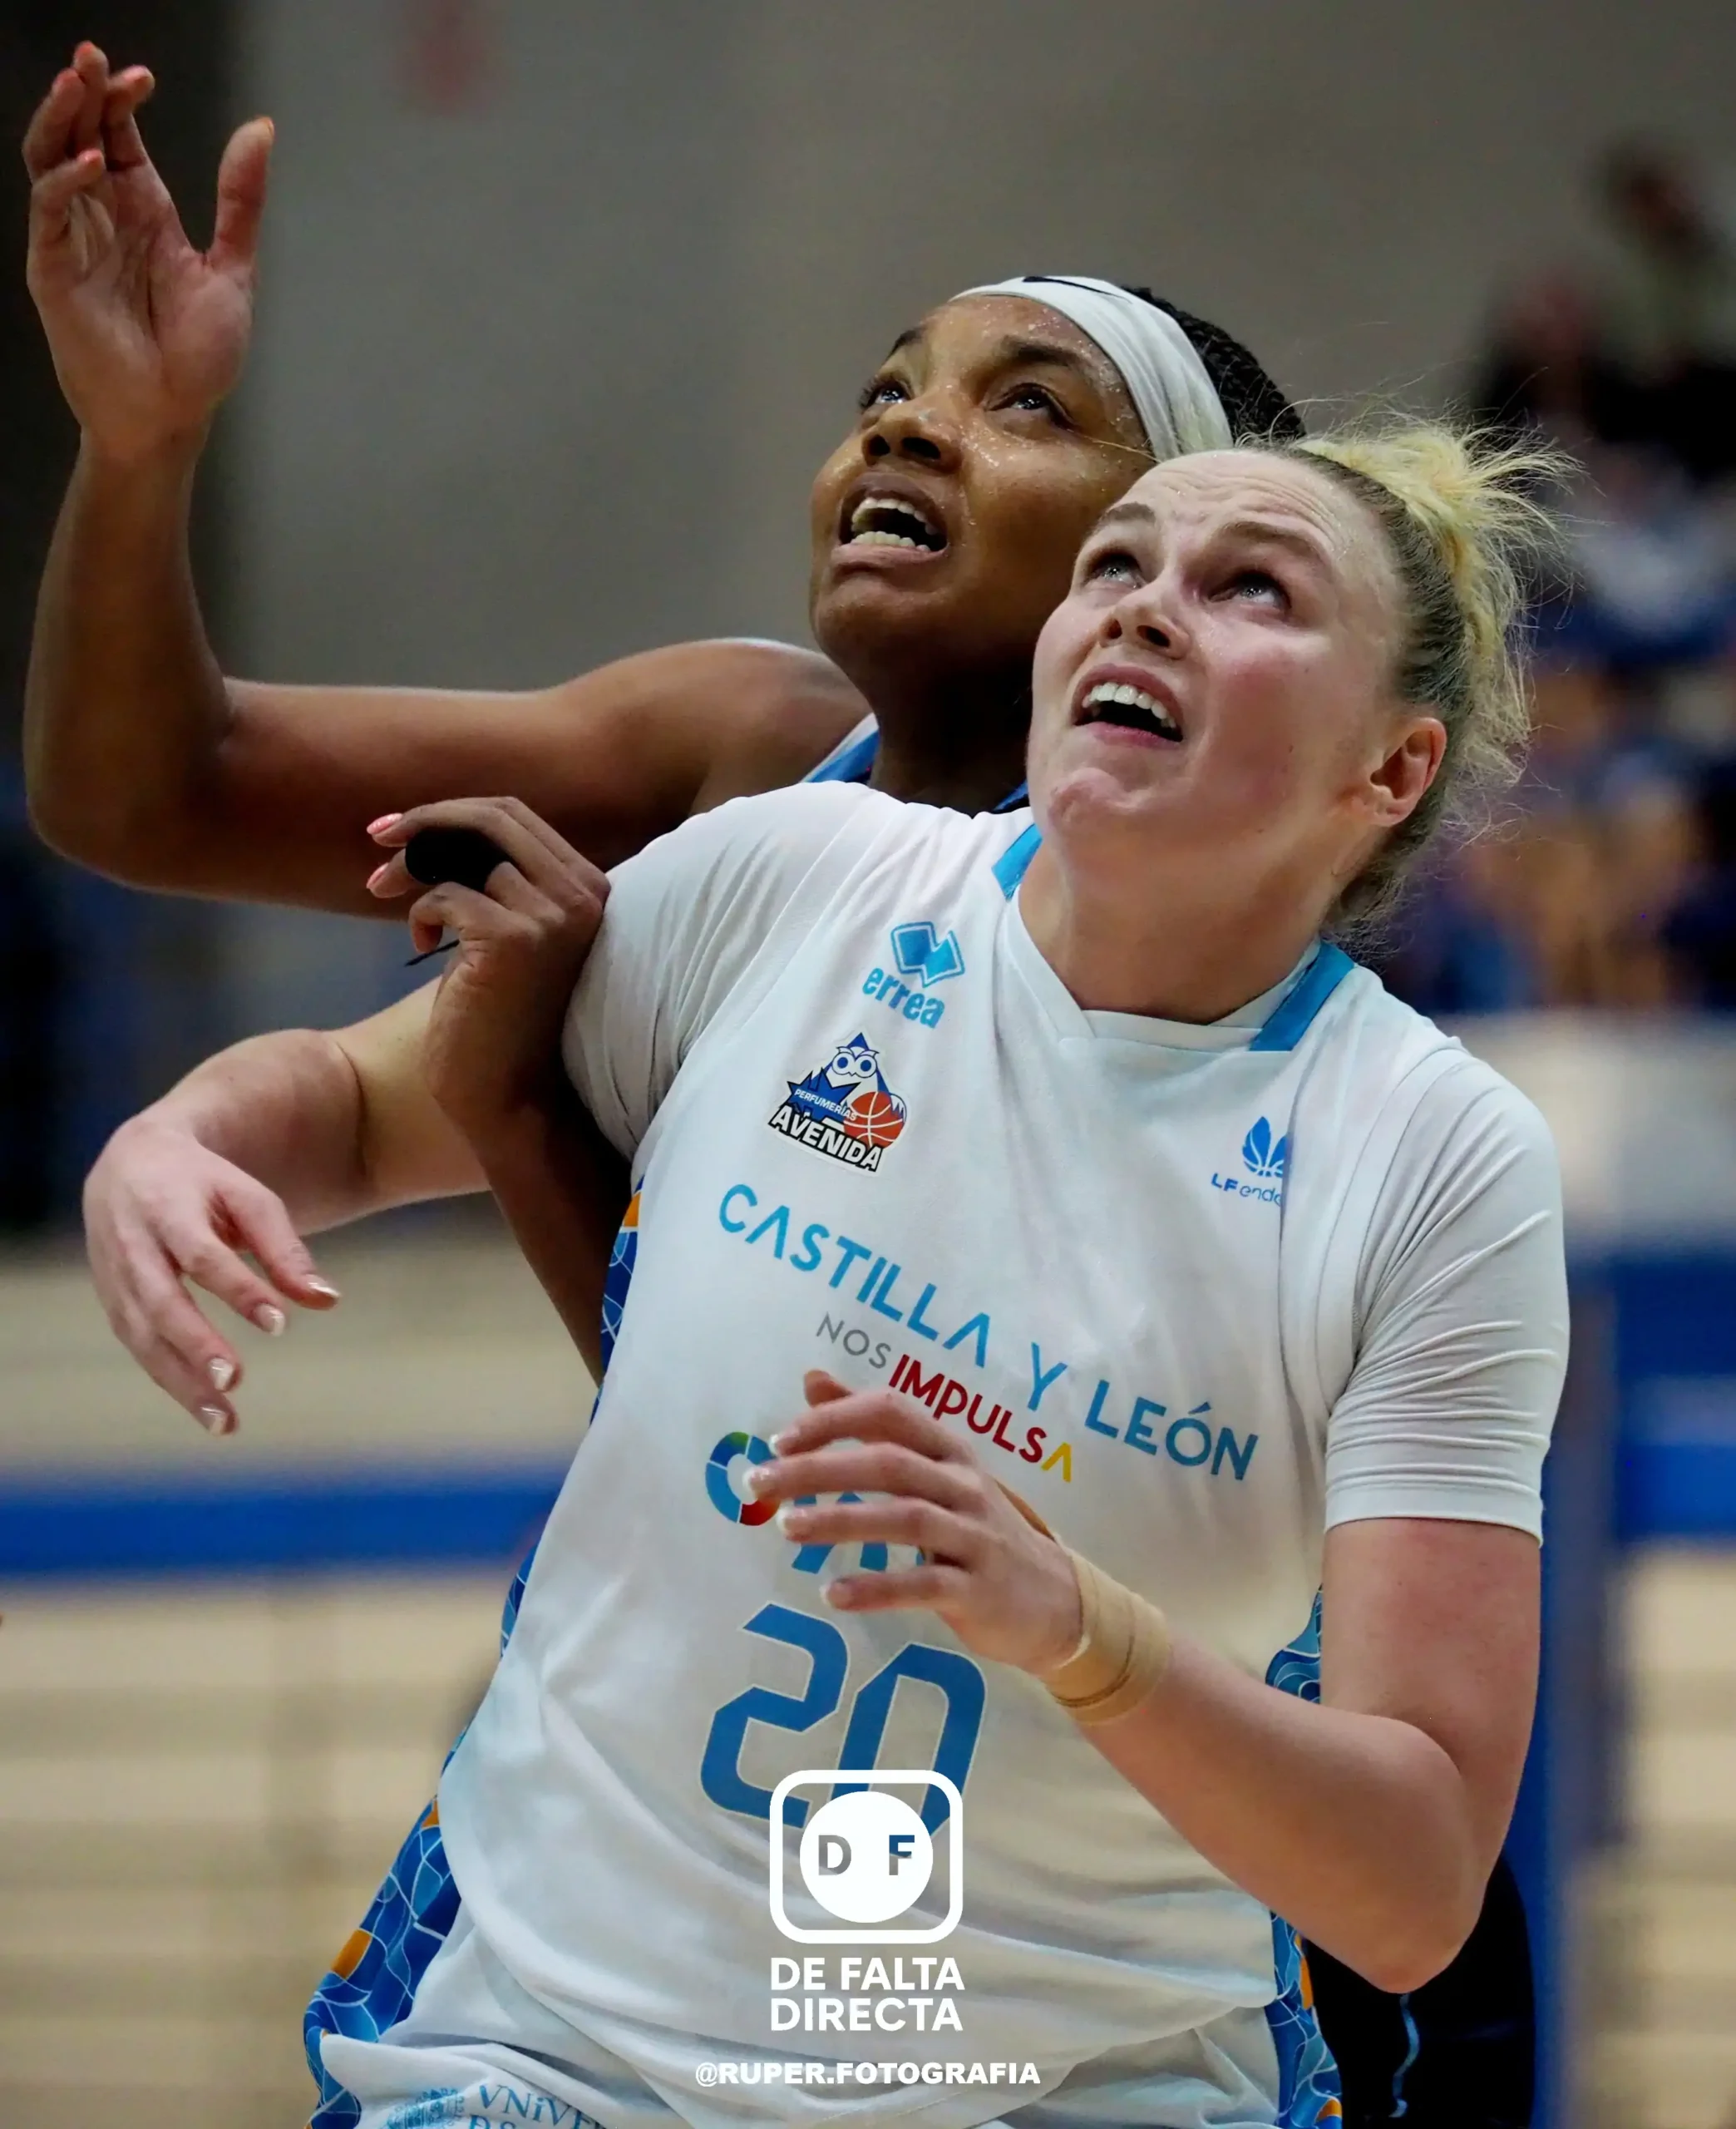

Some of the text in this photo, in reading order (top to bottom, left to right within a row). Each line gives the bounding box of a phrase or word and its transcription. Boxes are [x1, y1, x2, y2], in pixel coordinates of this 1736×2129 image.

[862, 967, 944, 1029] errea
[769, 1104, 883, 1172] AVENIDA
[718, 1183, 1258, 1481] CASTILLA Y LEÓN
[816, 1312, 1072, 1483] NOS IMPULSA
[701, 1603, 986, 1856] 20
